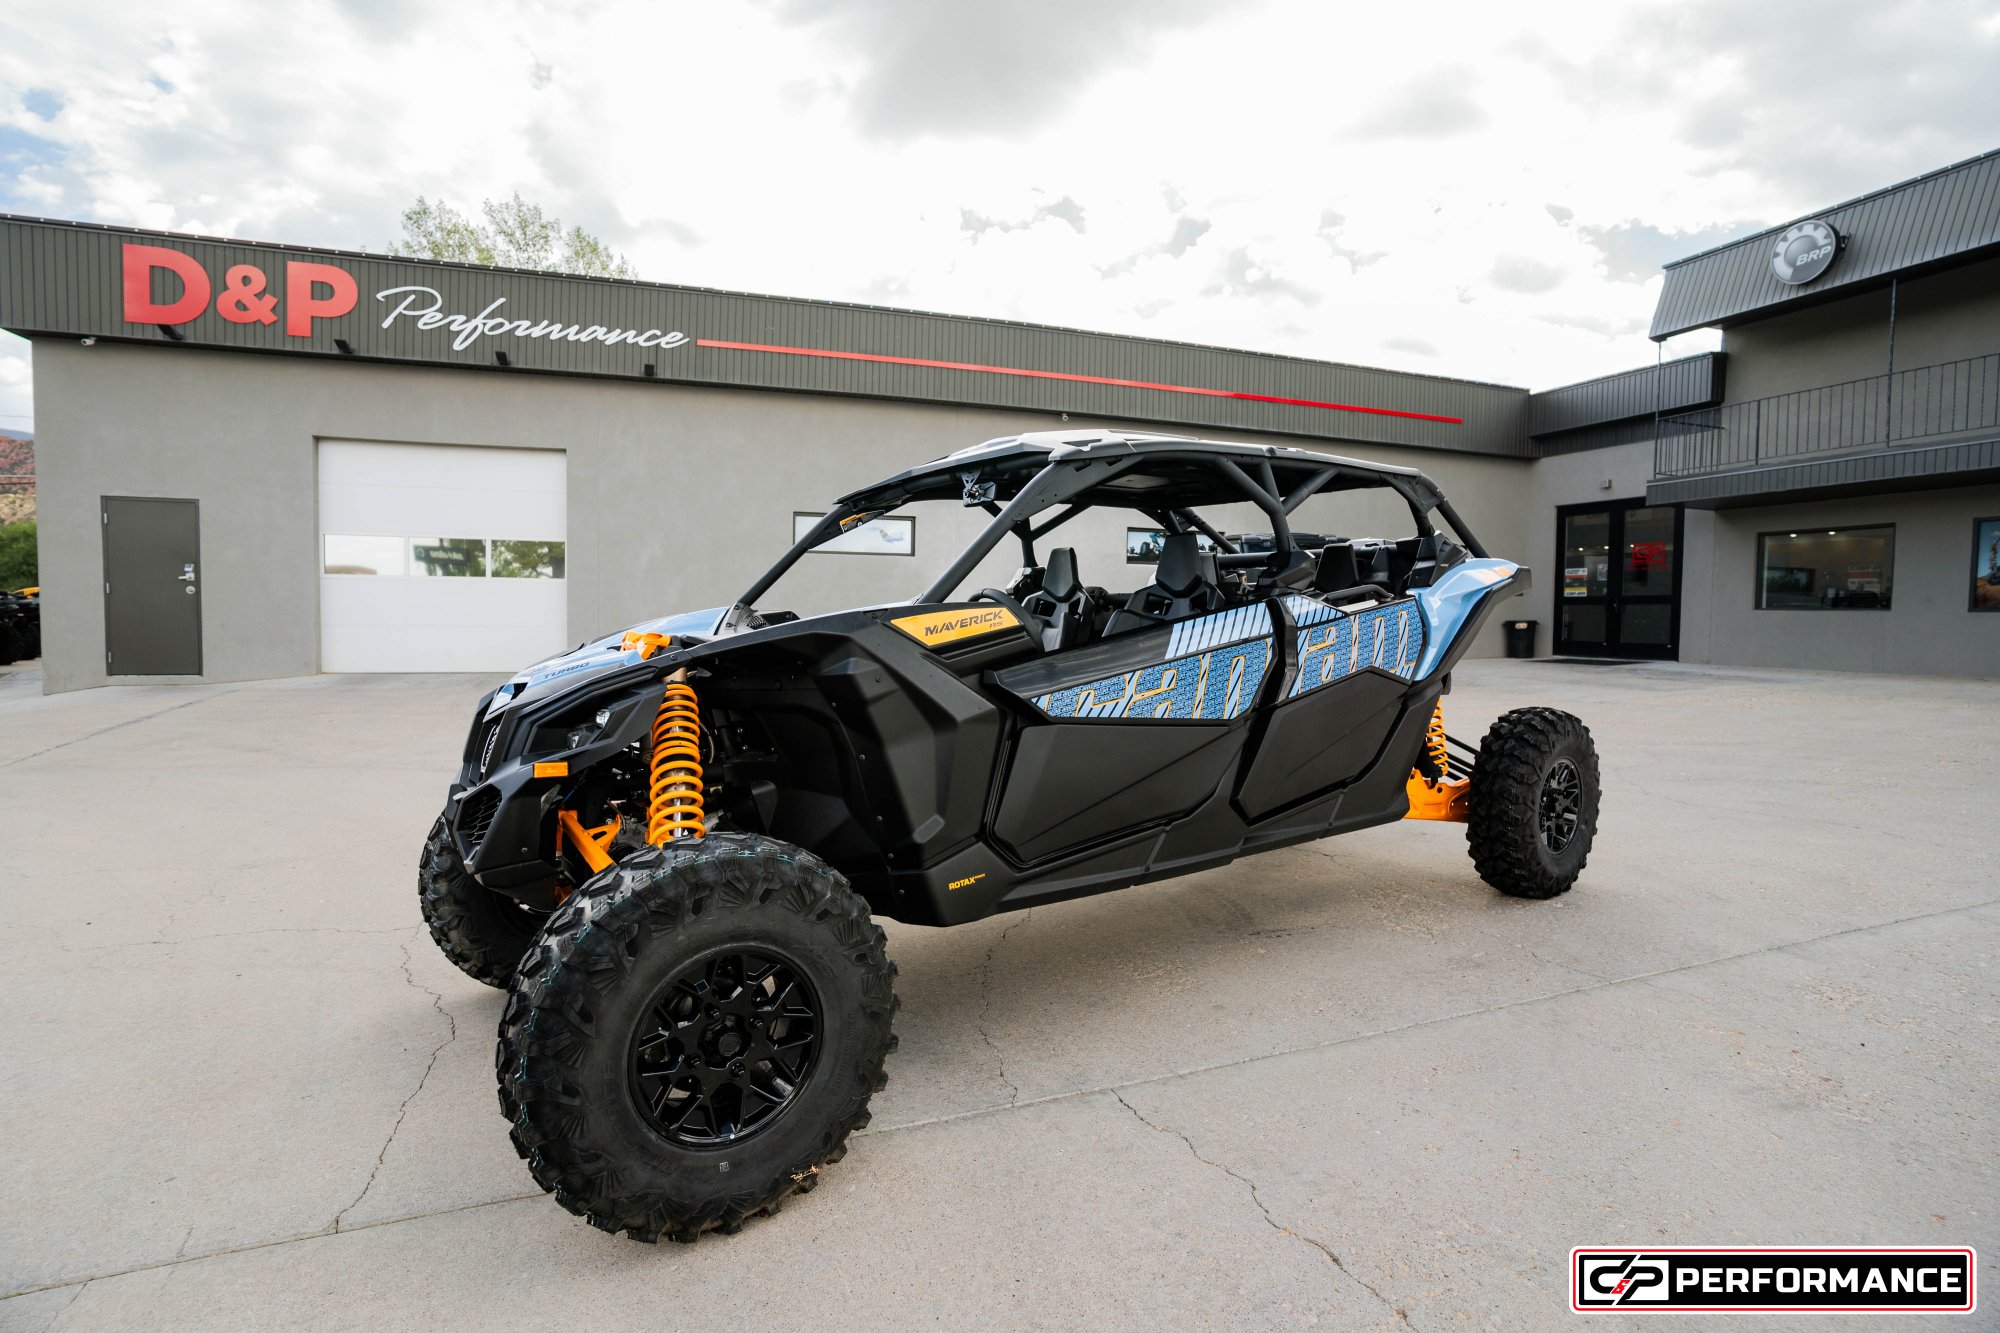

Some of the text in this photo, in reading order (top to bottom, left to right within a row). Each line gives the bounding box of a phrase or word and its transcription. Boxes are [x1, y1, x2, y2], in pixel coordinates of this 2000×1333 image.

[1796, 245, 1832, 266] BRP
[122, 243, 690, 351] D&P Performance
[924, 609, 1003, 637] MAVERICK
[544, 661, 591, 679] TURBO
[949, 876, 976, 891] ROTAX
